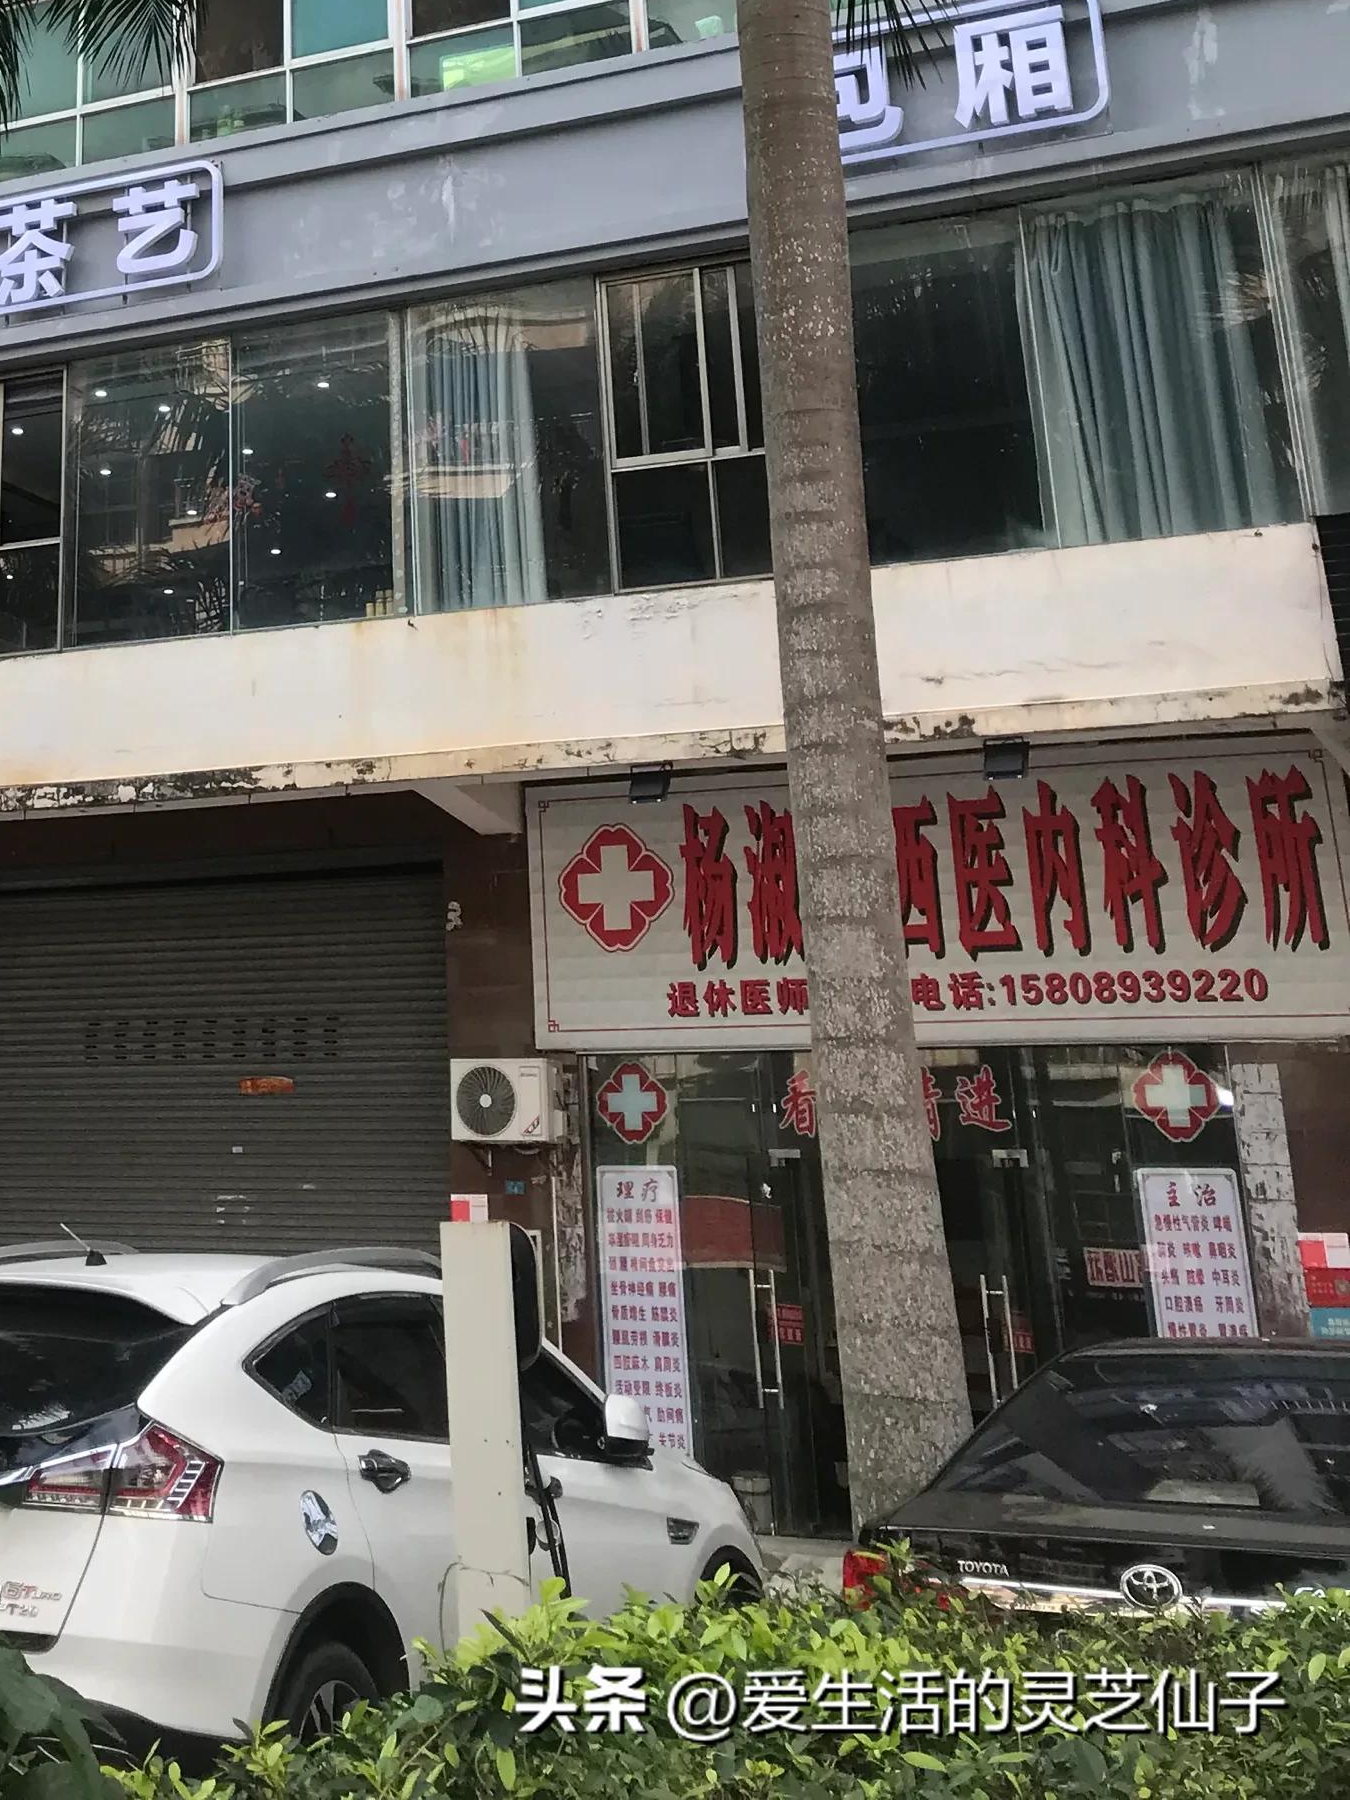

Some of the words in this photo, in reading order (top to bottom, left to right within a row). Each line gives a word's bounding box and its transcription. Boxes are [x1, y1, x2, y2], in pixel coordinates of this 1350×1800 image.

[667, 976, 810, 1018] 退休医师
[911, 968, 1269, 1011] 电话:15808939220
[616, 1178, 659, 1203] 理疗
[1167, 1181, 1217, 1208] 主治
[957, 1560, 1010, 1577] TOYOTA
